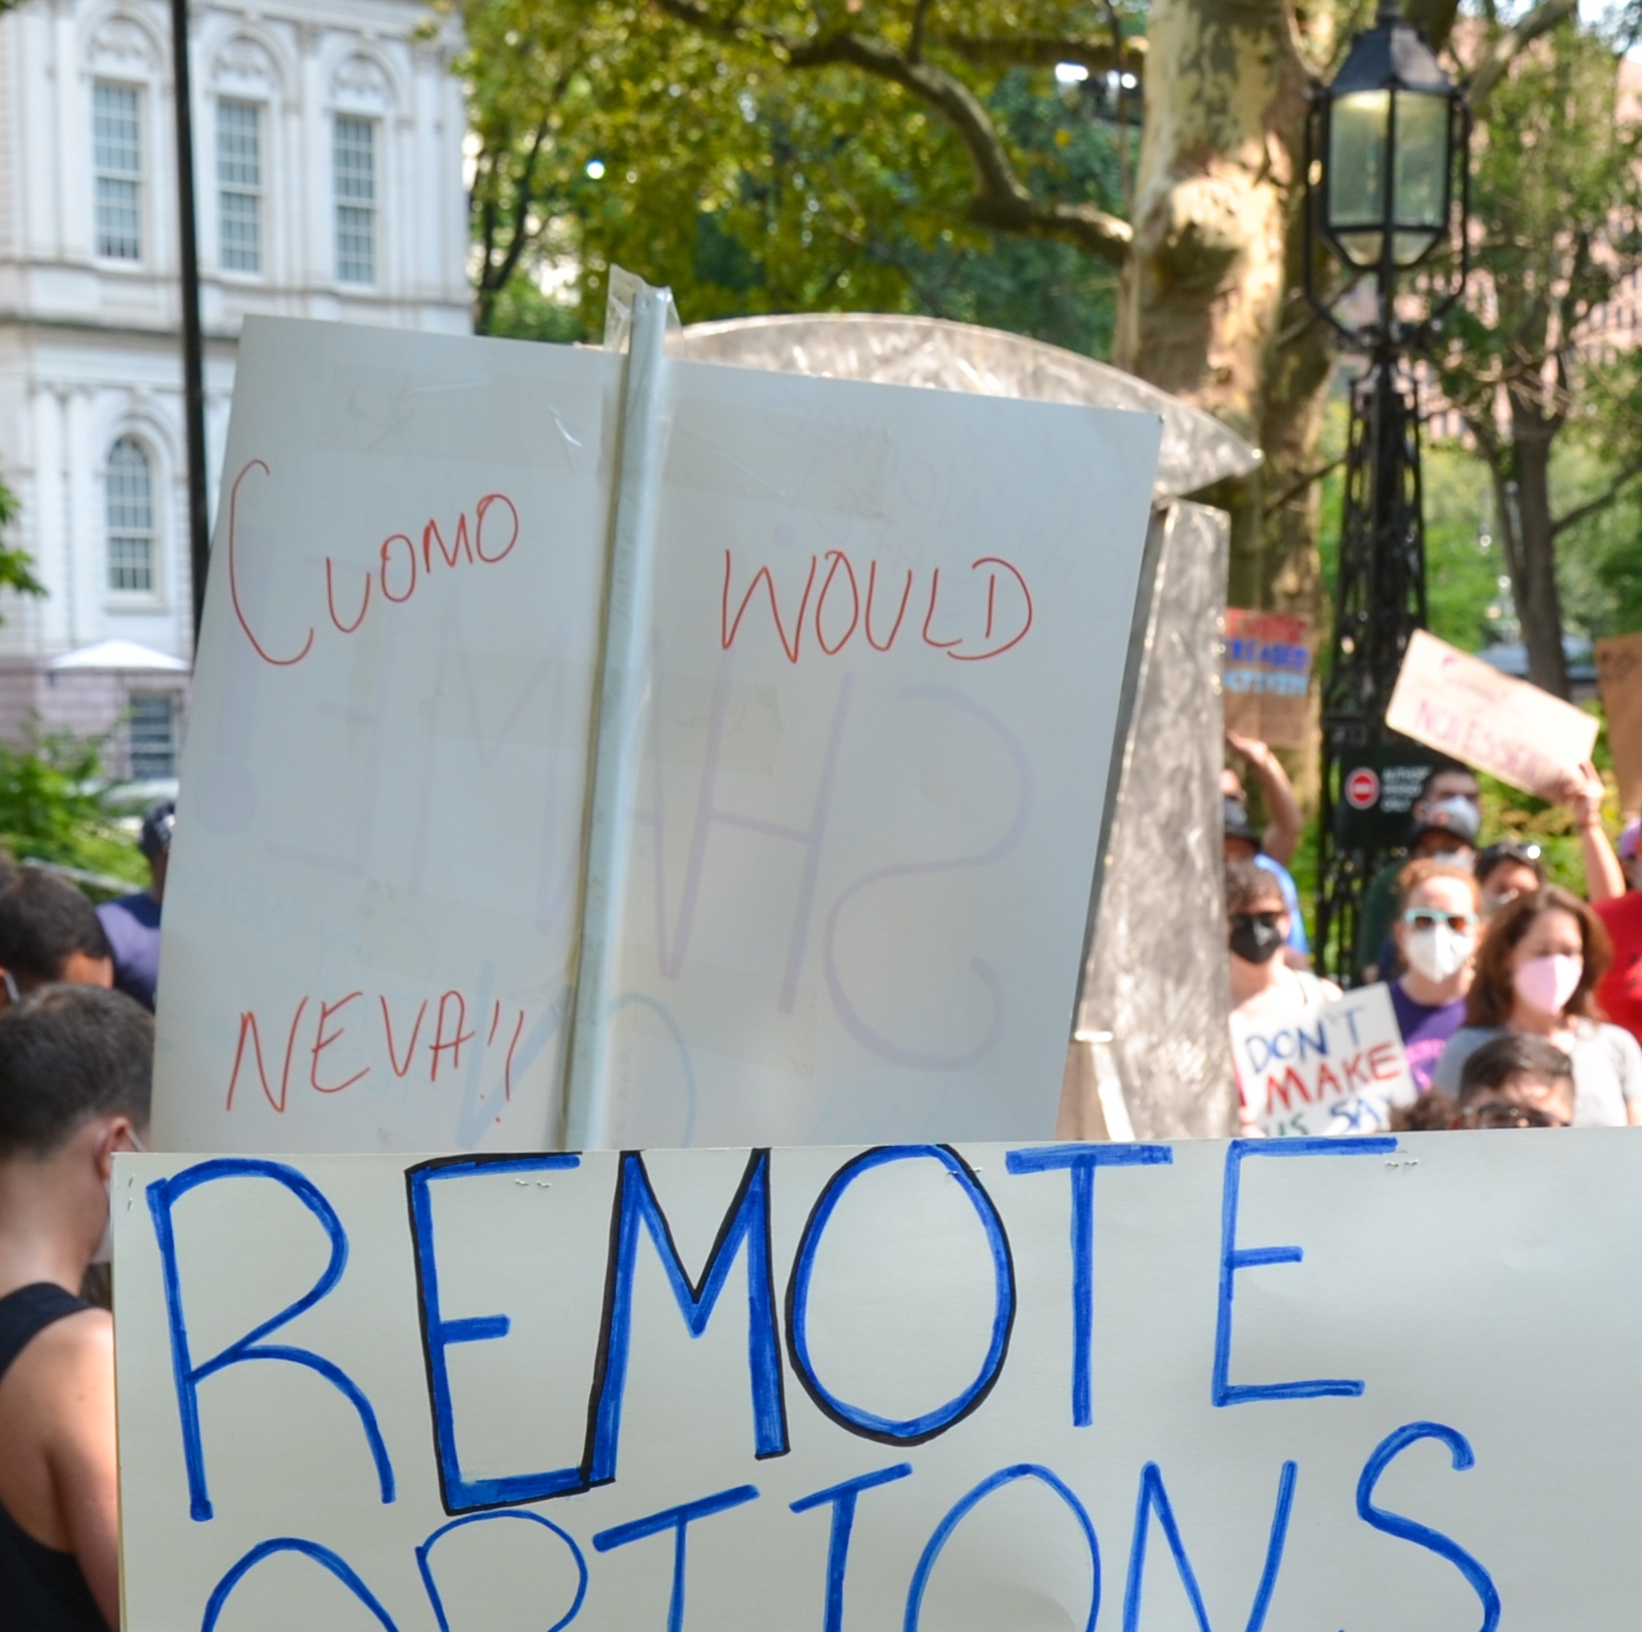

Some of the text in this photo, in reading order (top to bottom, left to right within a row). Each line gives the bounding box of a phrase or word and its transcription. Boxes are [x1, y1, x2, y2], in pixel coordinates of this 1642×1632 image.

[228, 458, 1034, 665] CUOMO WOULD
[1245, 1004, 1369, 1075] DON'T
[1264, 1041, 1402, 1117] MAKE
[145, 1137, 1398, 1522] REMOTE
